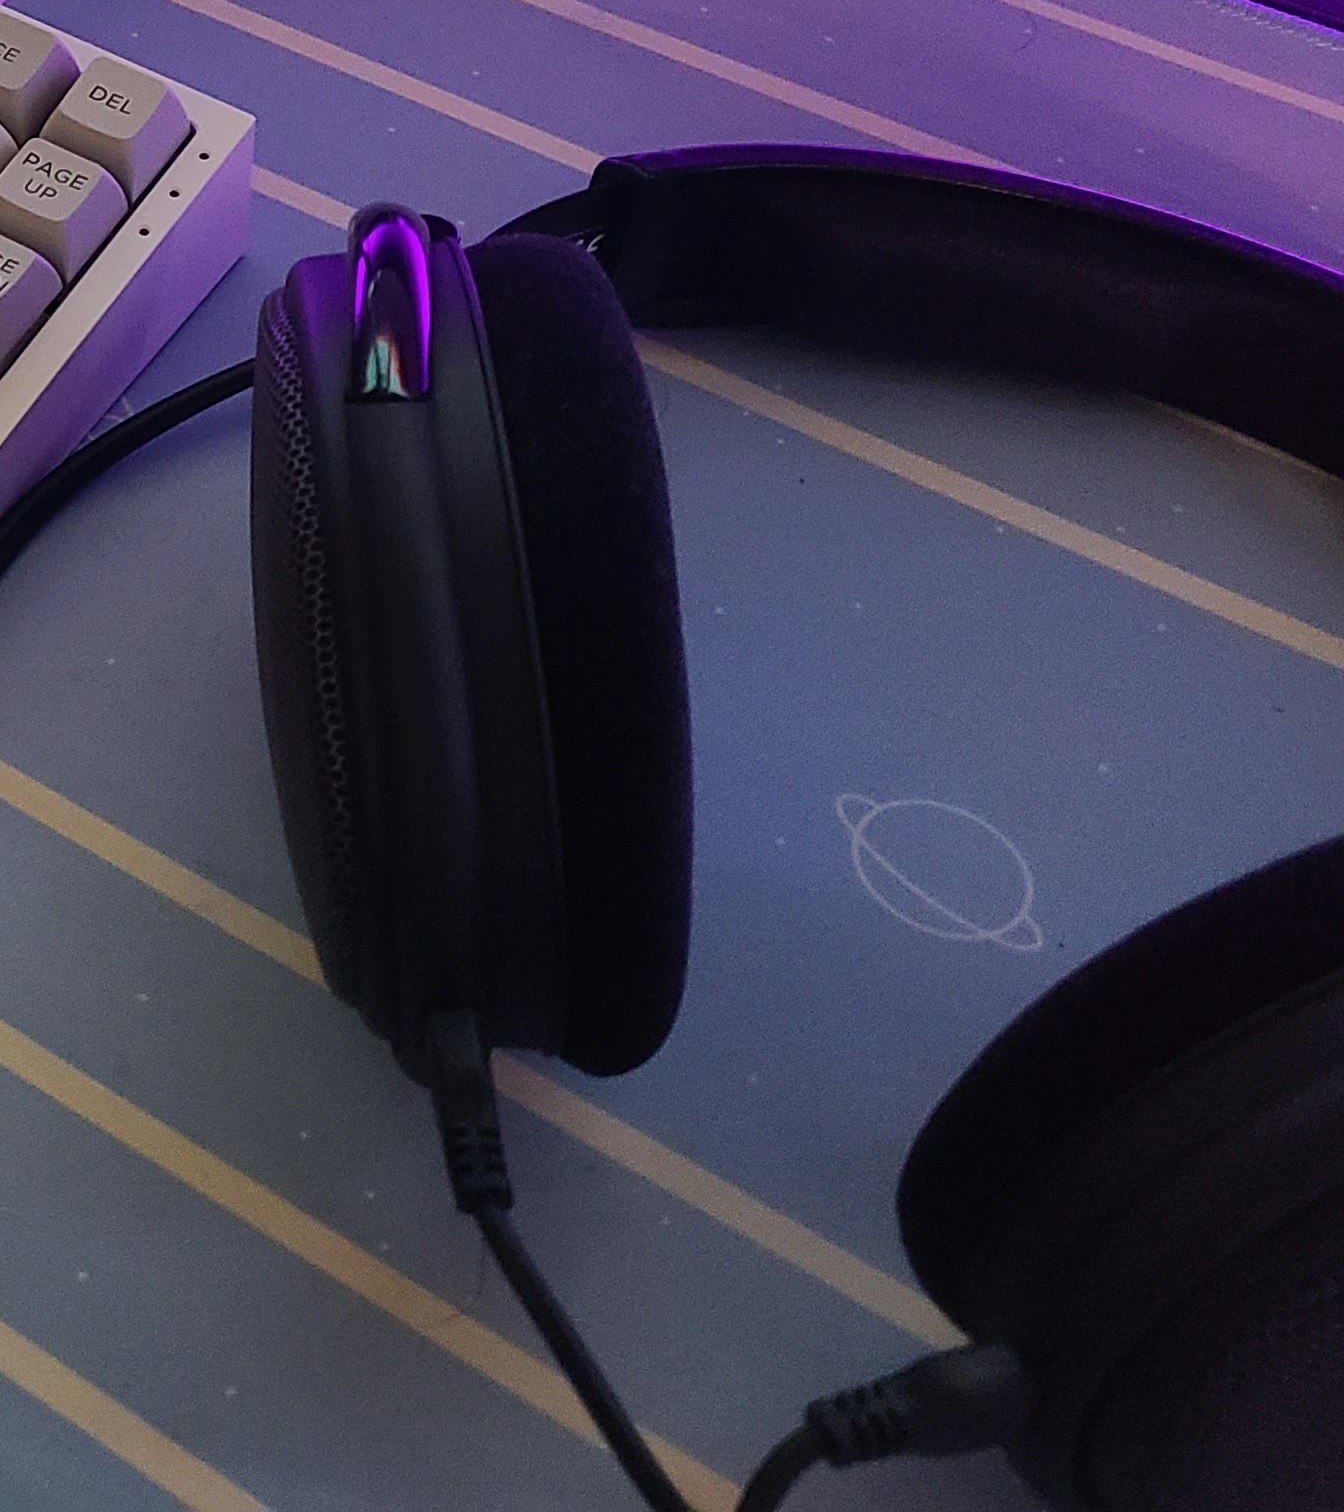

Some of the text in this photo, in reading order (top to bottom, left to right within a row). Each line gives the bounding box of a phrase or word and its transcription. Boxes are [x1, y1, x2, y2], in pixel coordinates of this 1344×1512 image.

[88, 85, 131, 115] DEL
[21, 152, 89, 191] PAGE
[24, 178, 58, 199] UP
